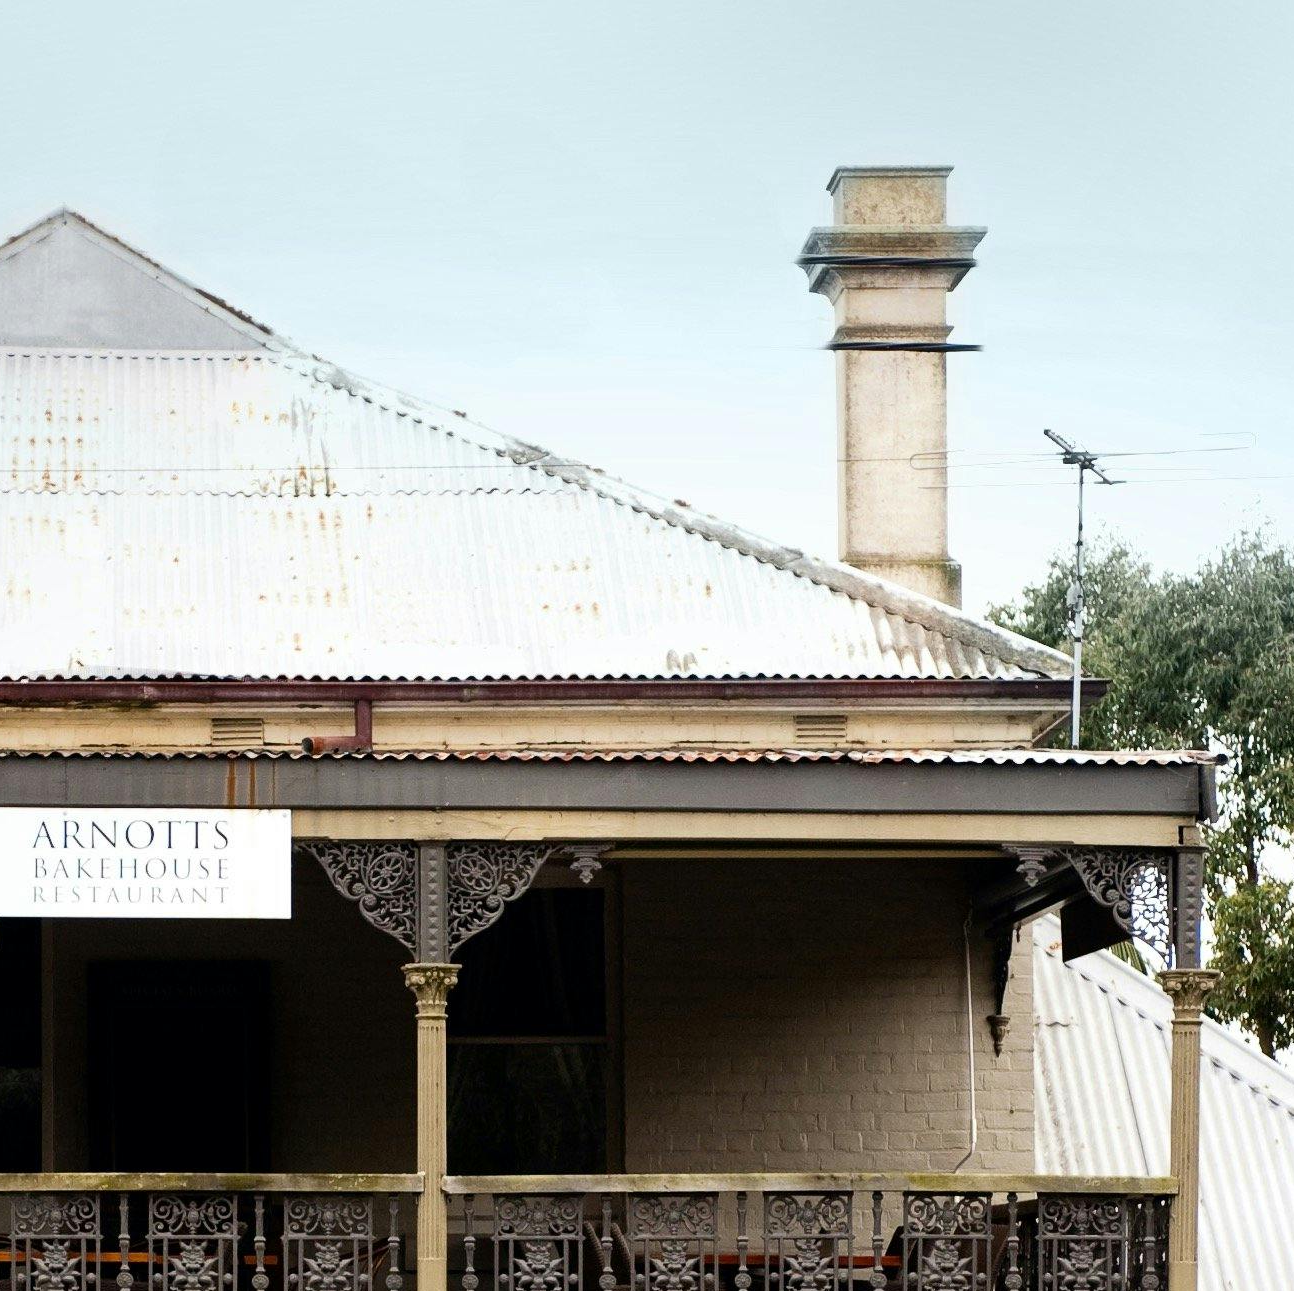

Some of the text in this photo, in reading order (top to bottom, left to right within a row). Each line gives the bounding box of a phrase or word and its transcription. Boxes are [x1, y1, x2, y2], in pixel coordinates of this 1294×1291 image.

[32, 819, 229, 850] ARNOTTS
[33, 857, 229, 880] BAKEHOUSE
[33, 886, 229, 904] RESTAURANT
